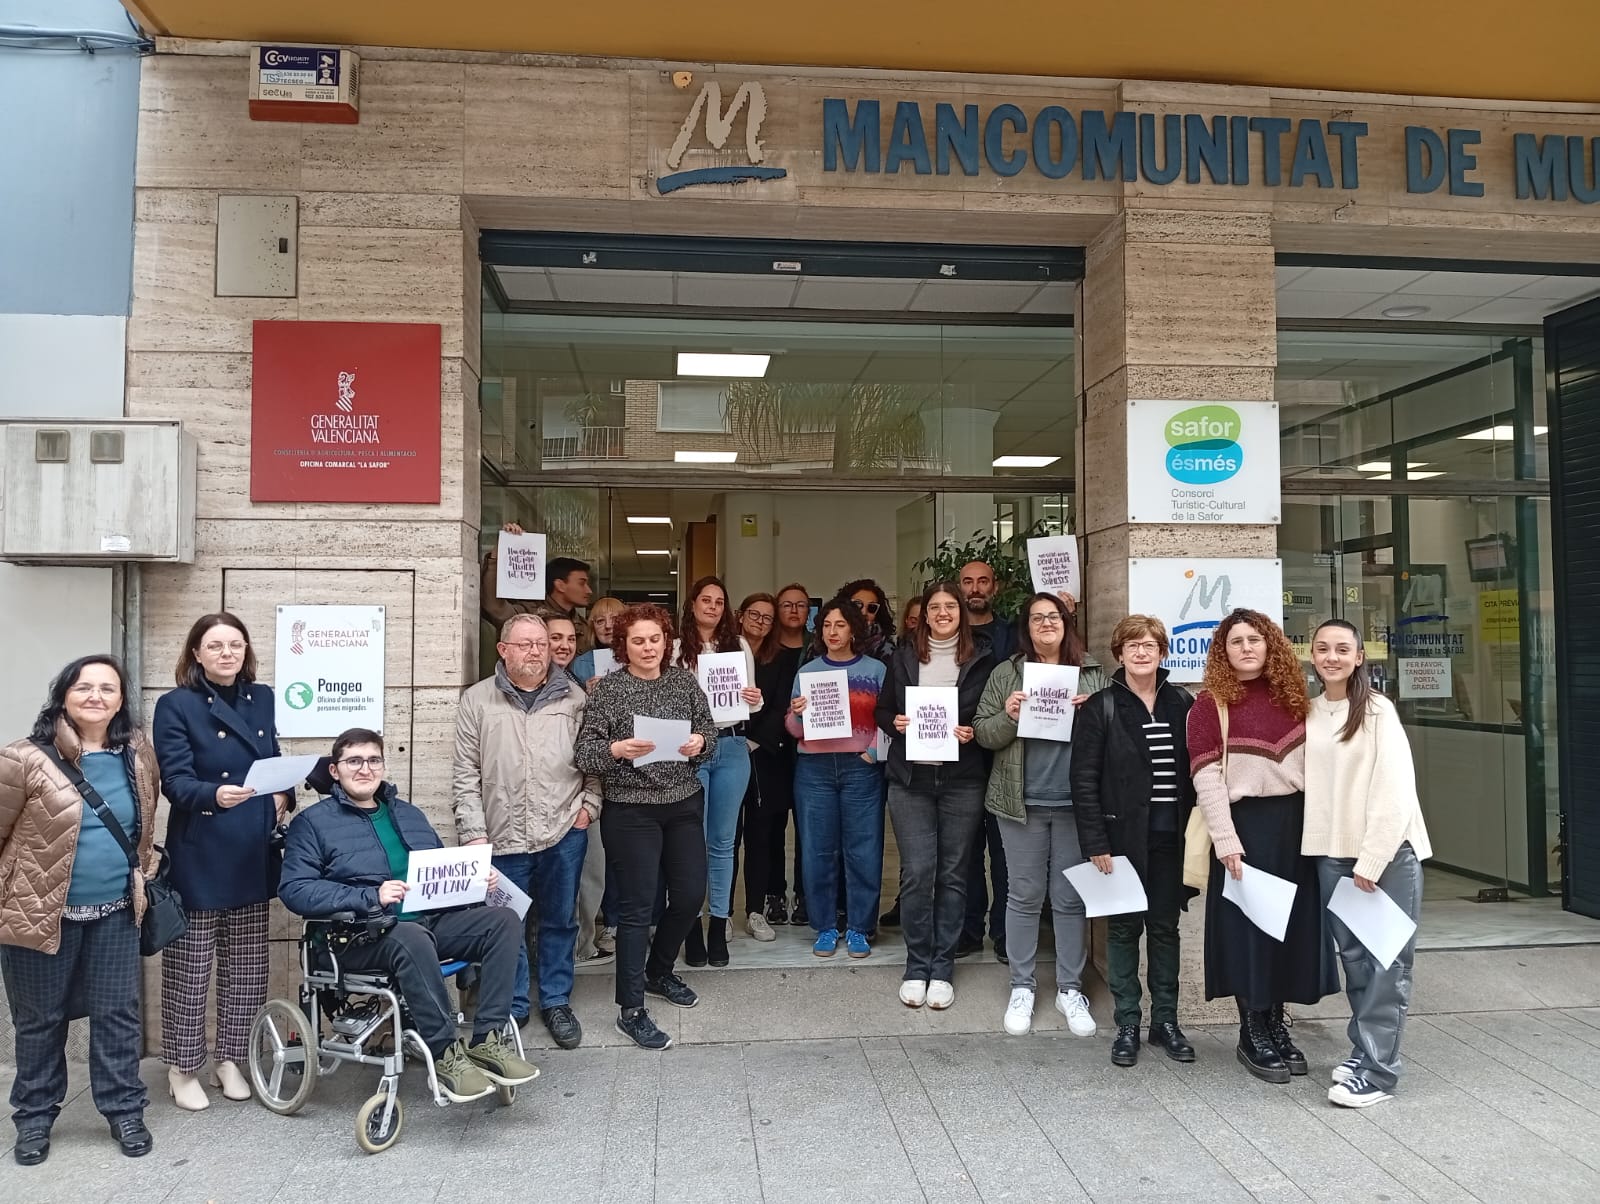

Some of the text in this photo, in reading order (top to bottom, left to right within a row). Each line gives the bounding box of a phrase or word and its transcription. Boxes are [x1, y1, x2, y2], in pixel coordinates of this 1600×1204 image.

[823, 98, 1368, 189] MANCOMUNITAT
[1405, 125, 1485, 197] DE
[311, 414, 380, 429] GENERALITAT
[1170, 416, 1234, 437] safor
[312, 430, 380, 444] VALENCIANA
[300, 460, 323, 468] OFICINA
[1171, 488, 1215, 498] Consorci
[1171, 500, 1246, 510] Turístic-Cultural
[1171, 511, 1224, 521] de la Safor
[307, 630, 370, 638] GENERALITAT
[308, 640, 369, 648] VALENCIANA
[318, 678, 362, 695] Pangea
[341, 705, 367, 713] migrades
[421, 880, 440, 900] TOT
